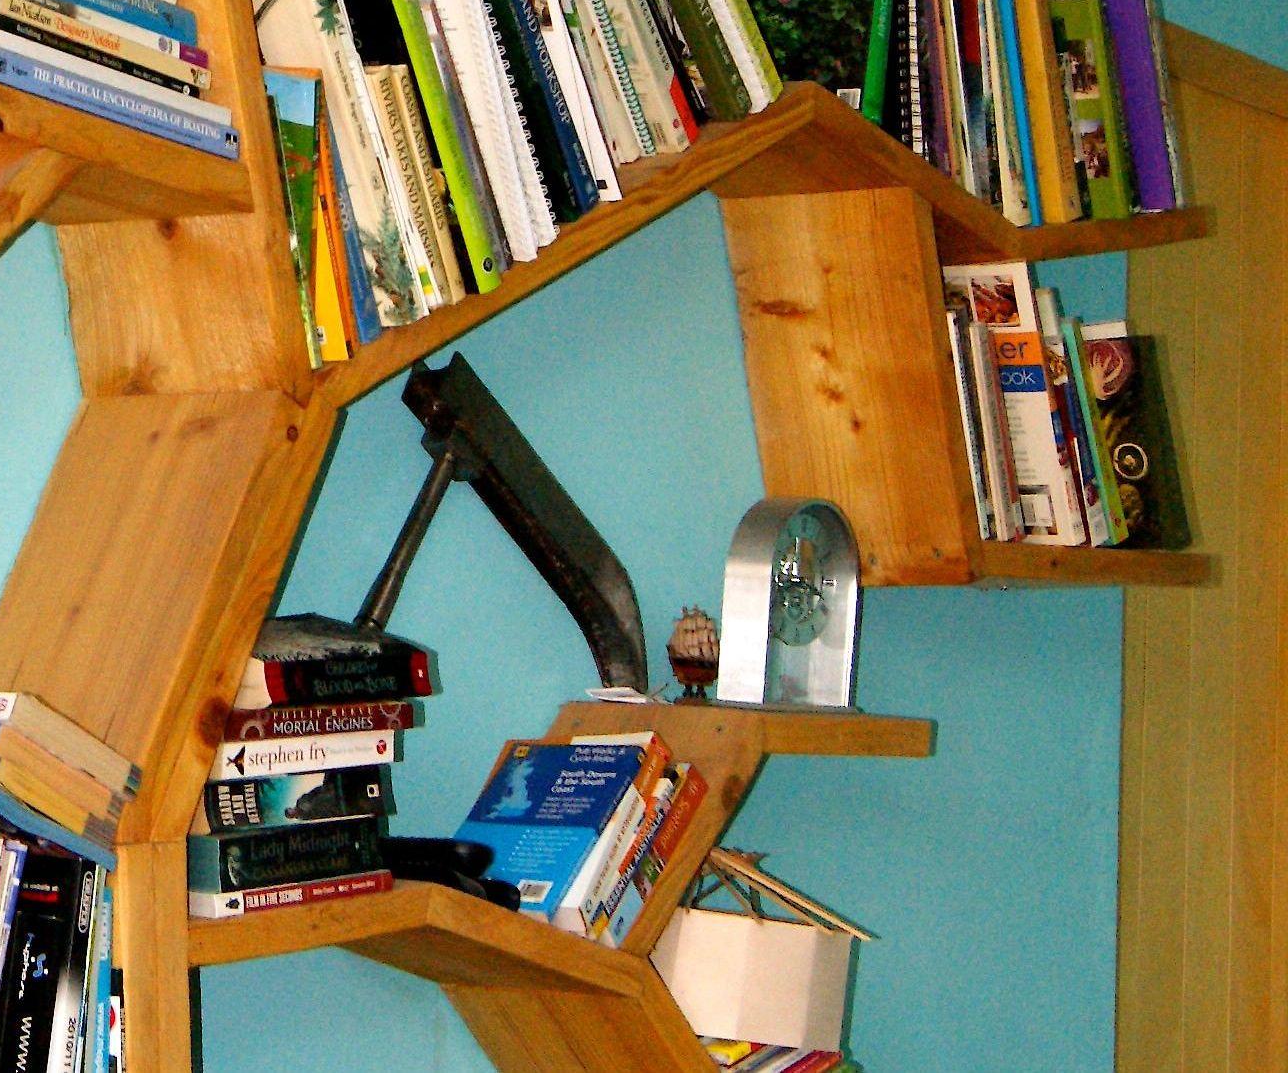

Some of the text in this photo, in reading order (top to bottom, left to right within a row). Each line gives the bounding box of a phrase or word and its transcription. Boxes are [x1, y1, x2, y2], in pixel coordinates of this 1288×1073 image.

[33, 67, 52, 81] THE
[53, 72, 102, 96] PRACTICAL
[102, 87, 169, 120] ENCYCLOPEDIA
[169, 111, 182, 125] OF
[183, 115, 220, 139] BOATING
[529, 35, 576, 125] WORKSHOP
[375, 76, 444, 268] RIVERS LAKES AND MARSHES
[396, 74, 449, 230] COASTS AND ESTUARIES
[248, 742, 328, 771] stephen fry
[273, 715, 373, 735] MORTAL ENGINES
